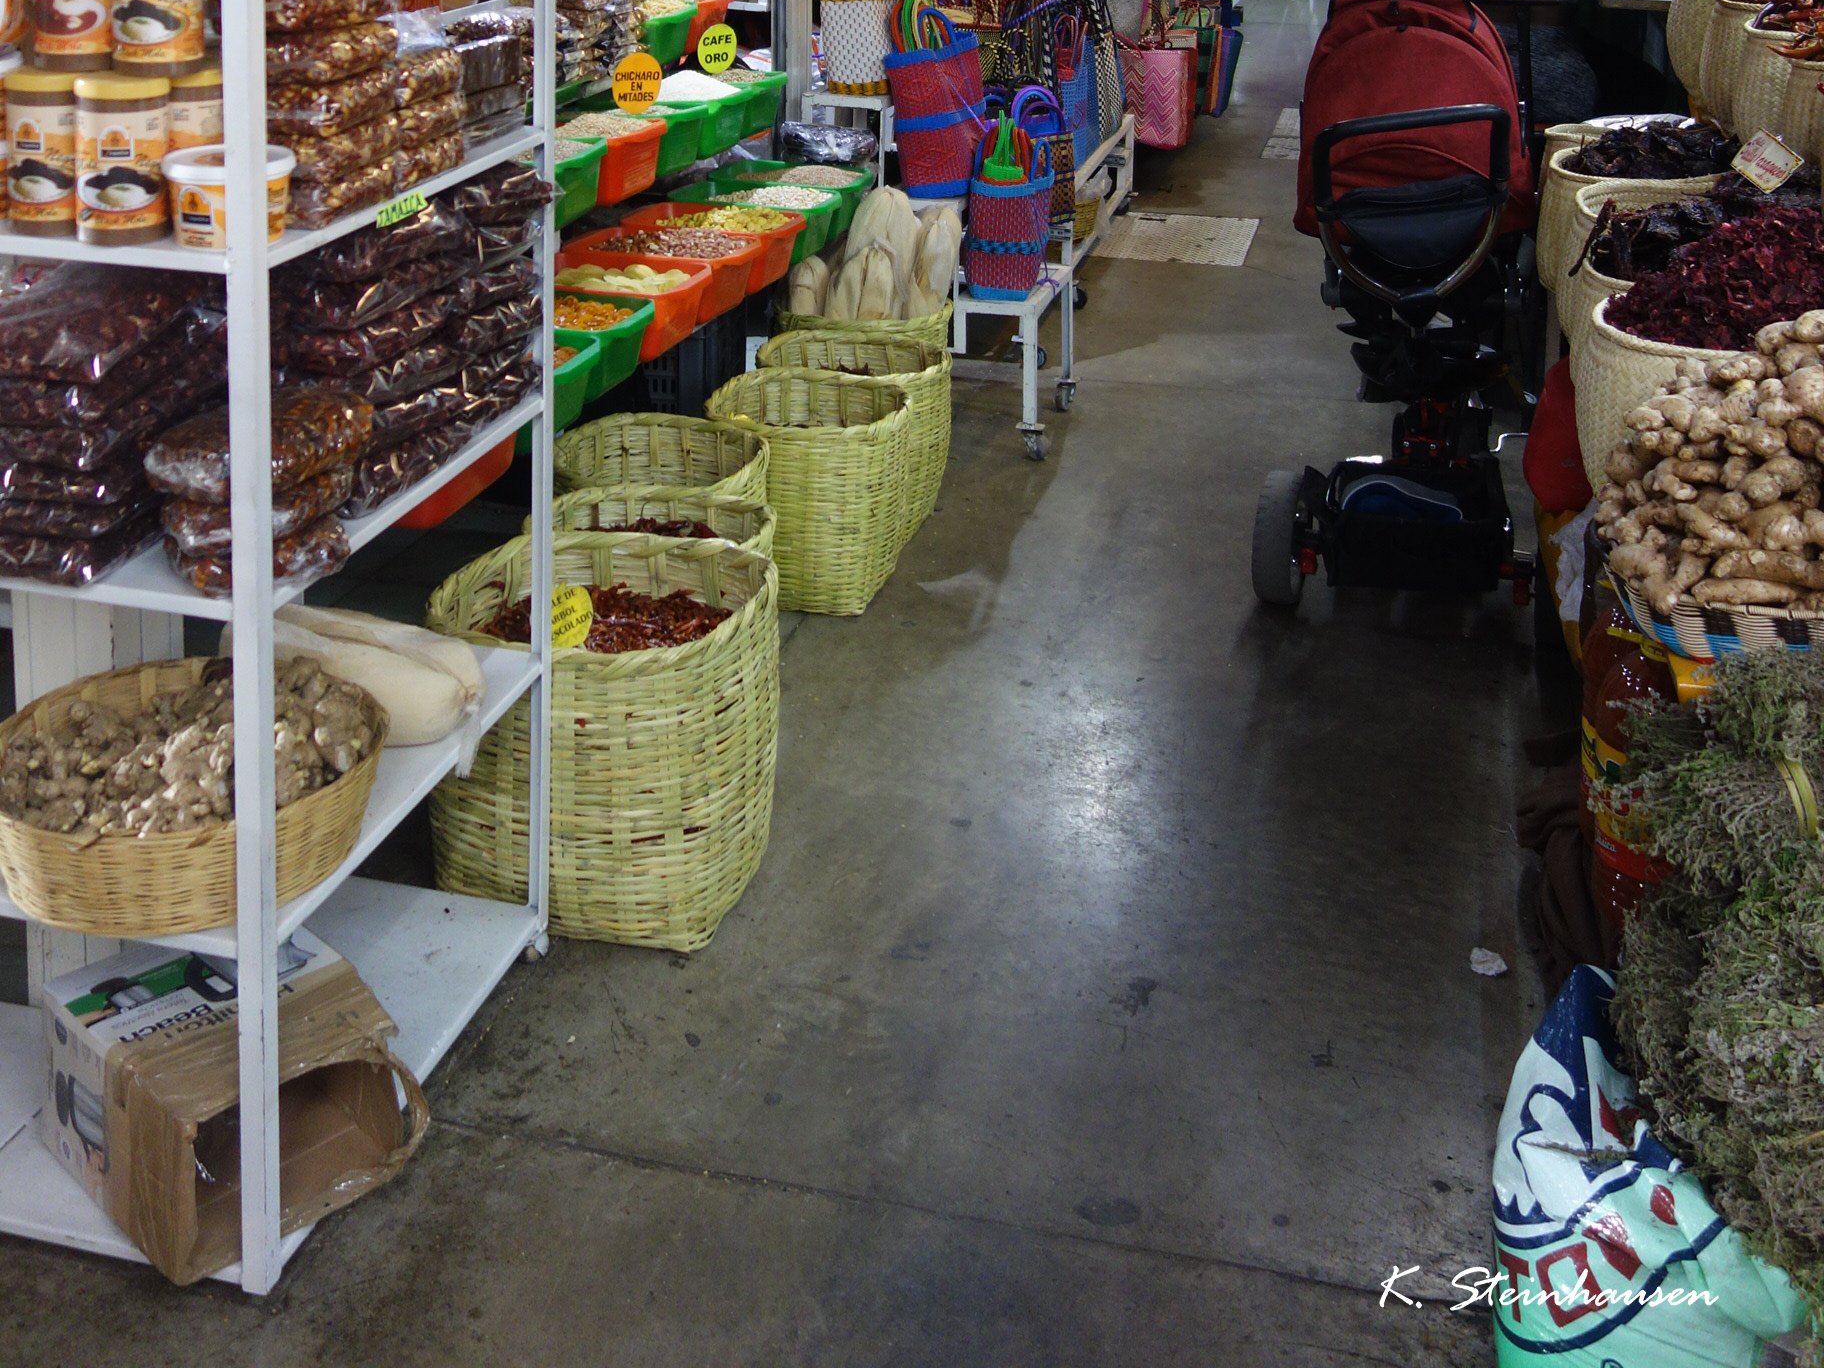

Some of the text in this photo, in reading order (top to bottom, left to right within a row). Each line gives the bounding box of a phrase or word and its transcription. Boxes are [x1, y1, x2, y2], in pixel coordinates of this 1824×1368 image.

[702, 34, 733, 47] CAFE
[704, 52, 729, 64] ORO
[615, 70, 660, 82] CHICHARO
[630, 81, 643, 91] EN
[617, 91, 654, 102] MITADES
[564, 587, 576, 600] DE
[118, 1002, 214, 1045] Beach
